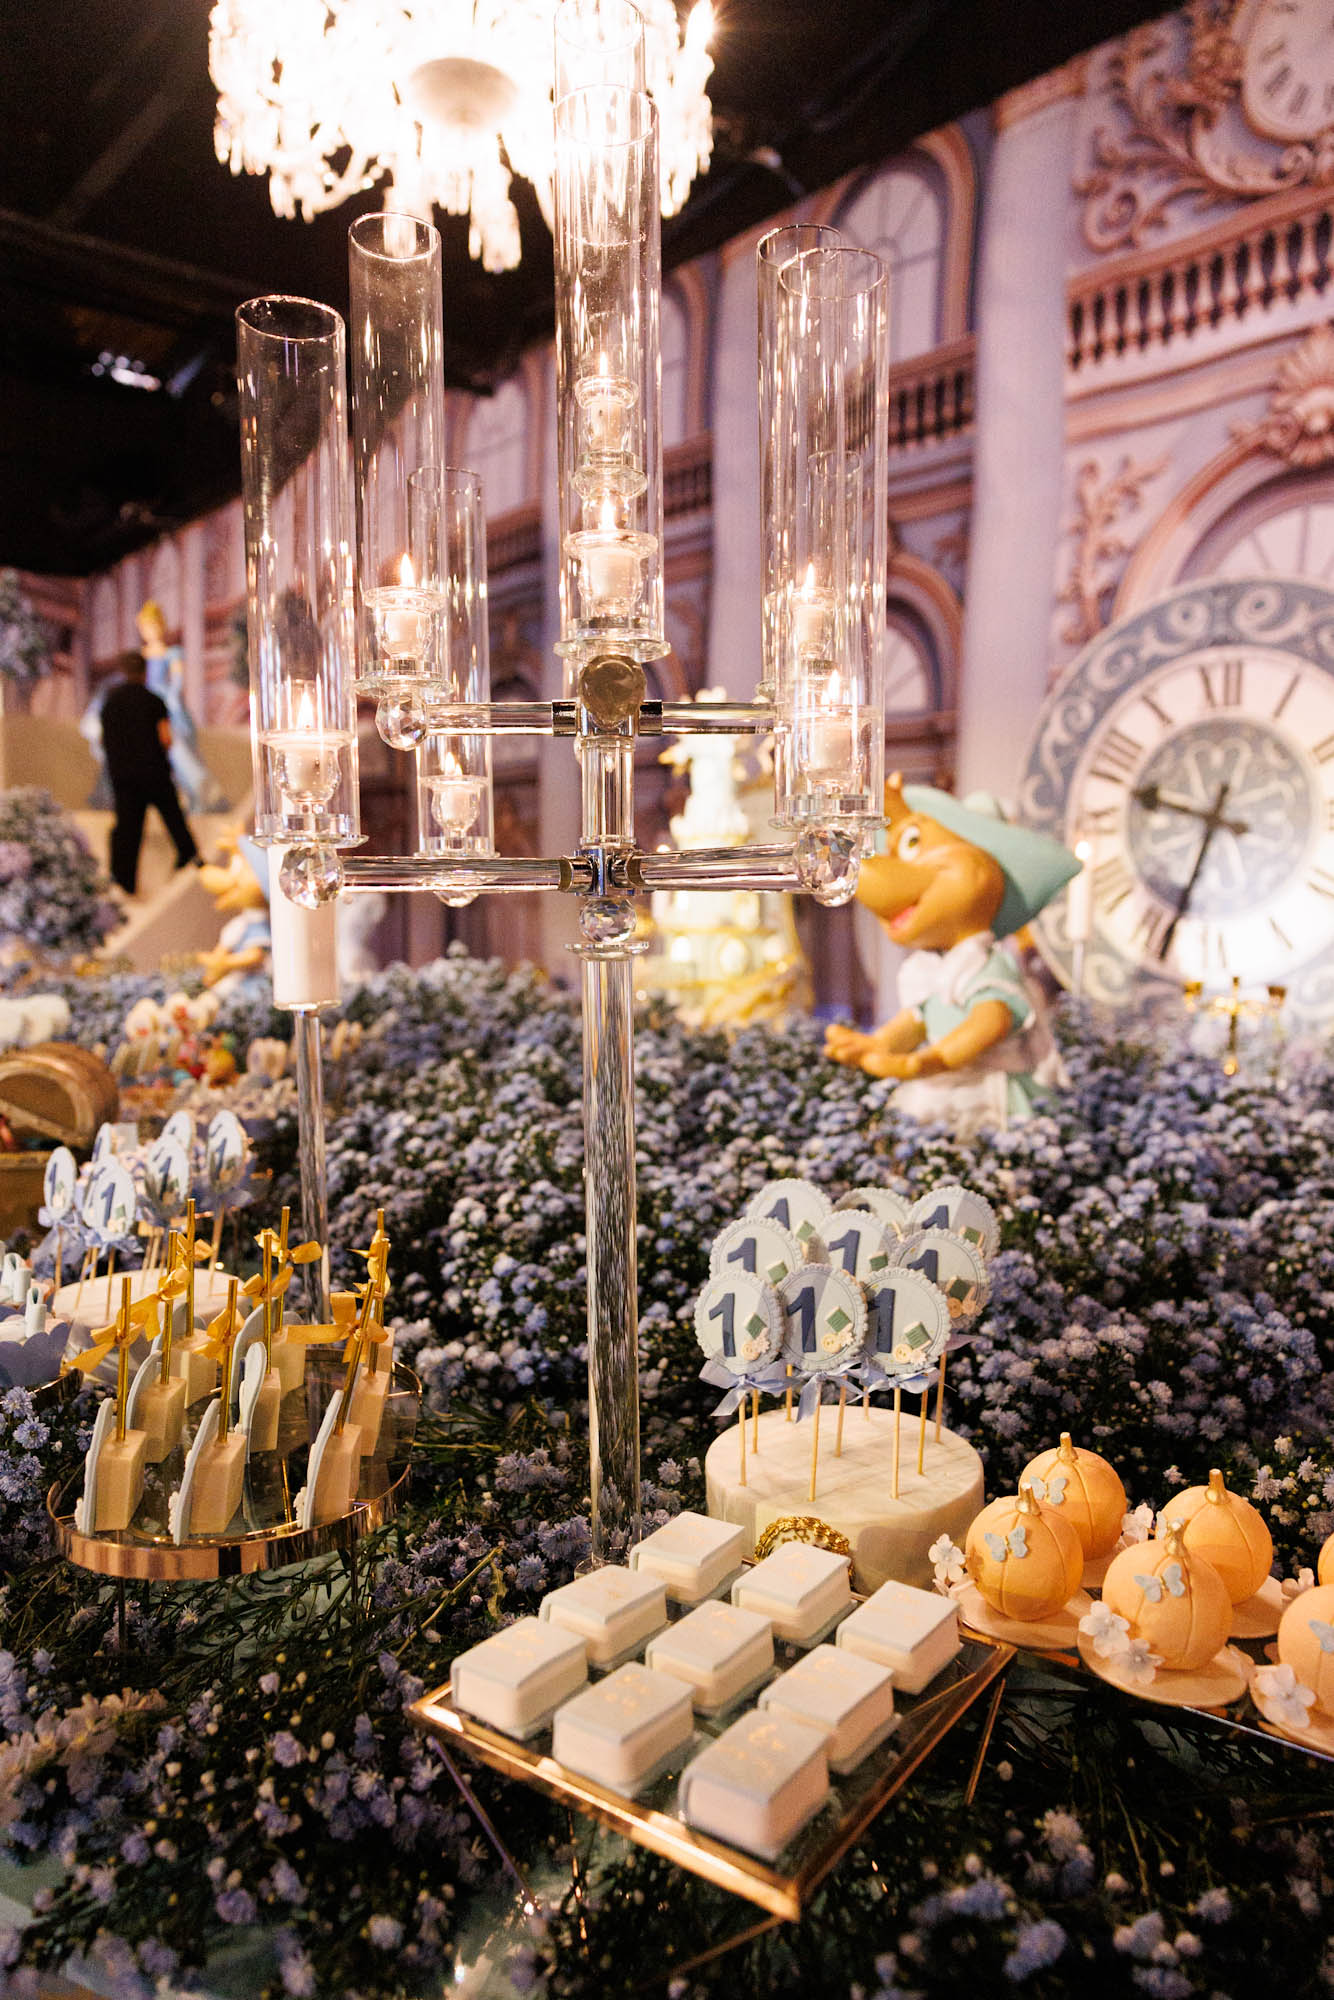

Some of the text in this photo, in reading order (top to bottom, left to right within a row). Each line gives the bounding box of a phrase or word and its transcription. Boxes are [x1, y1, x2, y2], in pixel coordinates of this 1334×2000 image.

[101, 1182, 116, 1228] 1
[159, 1156, 172, 1200] 1
[828, 1229, 860, 1276] 1
[709, 1292, 736, 1357] 1
[786, 1286, 816, 1353] 1
[867, 1288, 896, 1353] 1
